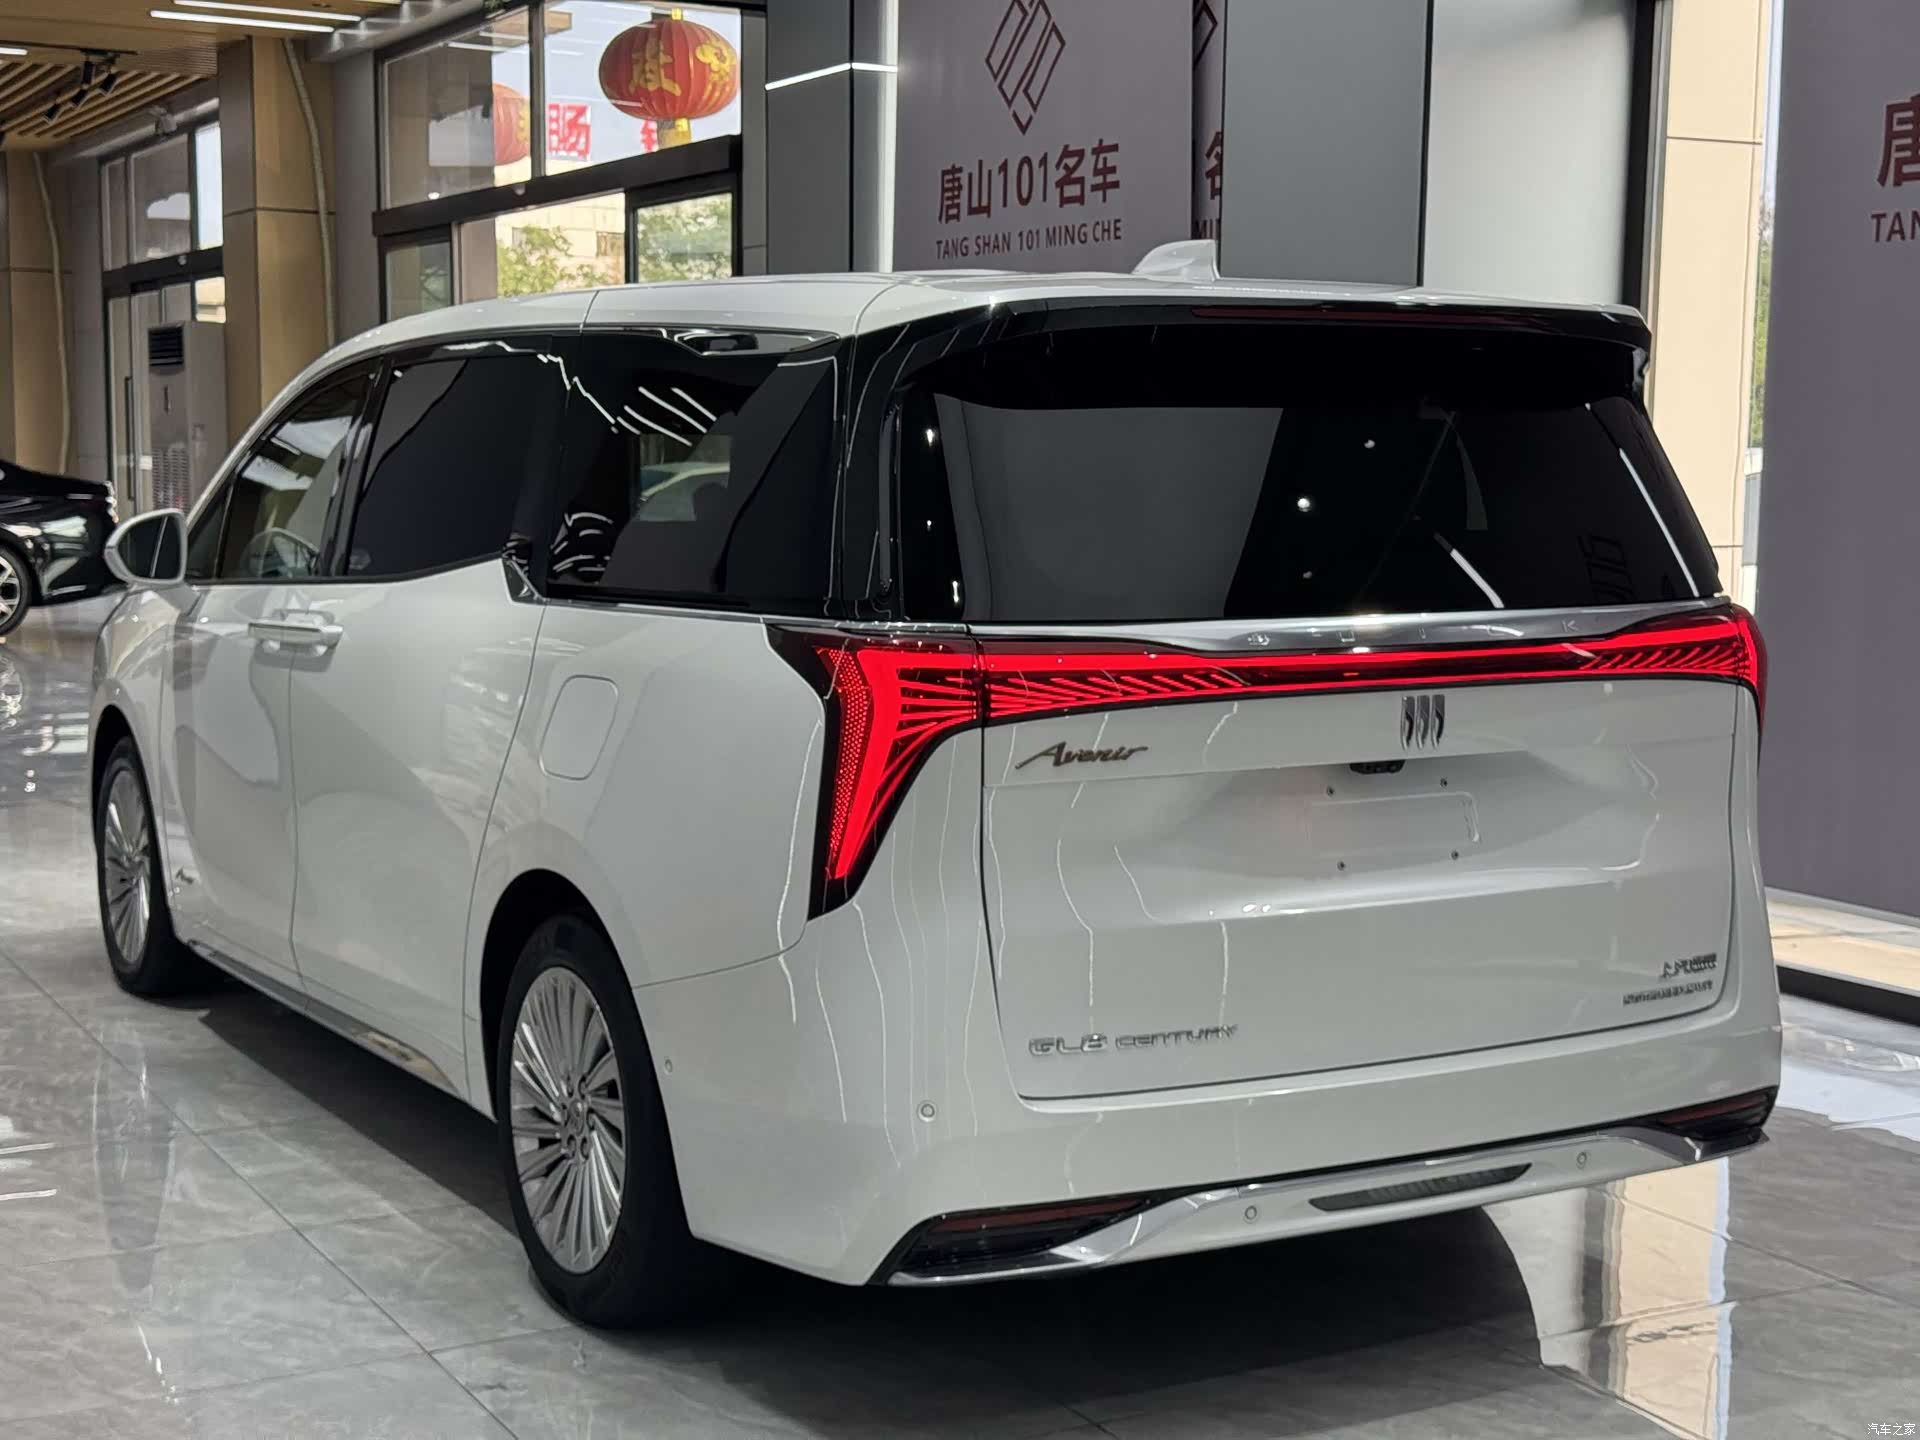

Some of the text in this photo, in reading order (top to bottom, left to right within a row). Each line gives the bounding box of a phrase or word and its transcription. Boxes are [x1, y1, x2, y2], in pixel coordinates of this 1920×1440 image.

[938, 138, 1120, 224] 唐山101名车
[936, 219, 1121, 260] TANG SHAN 101 MING CHE
